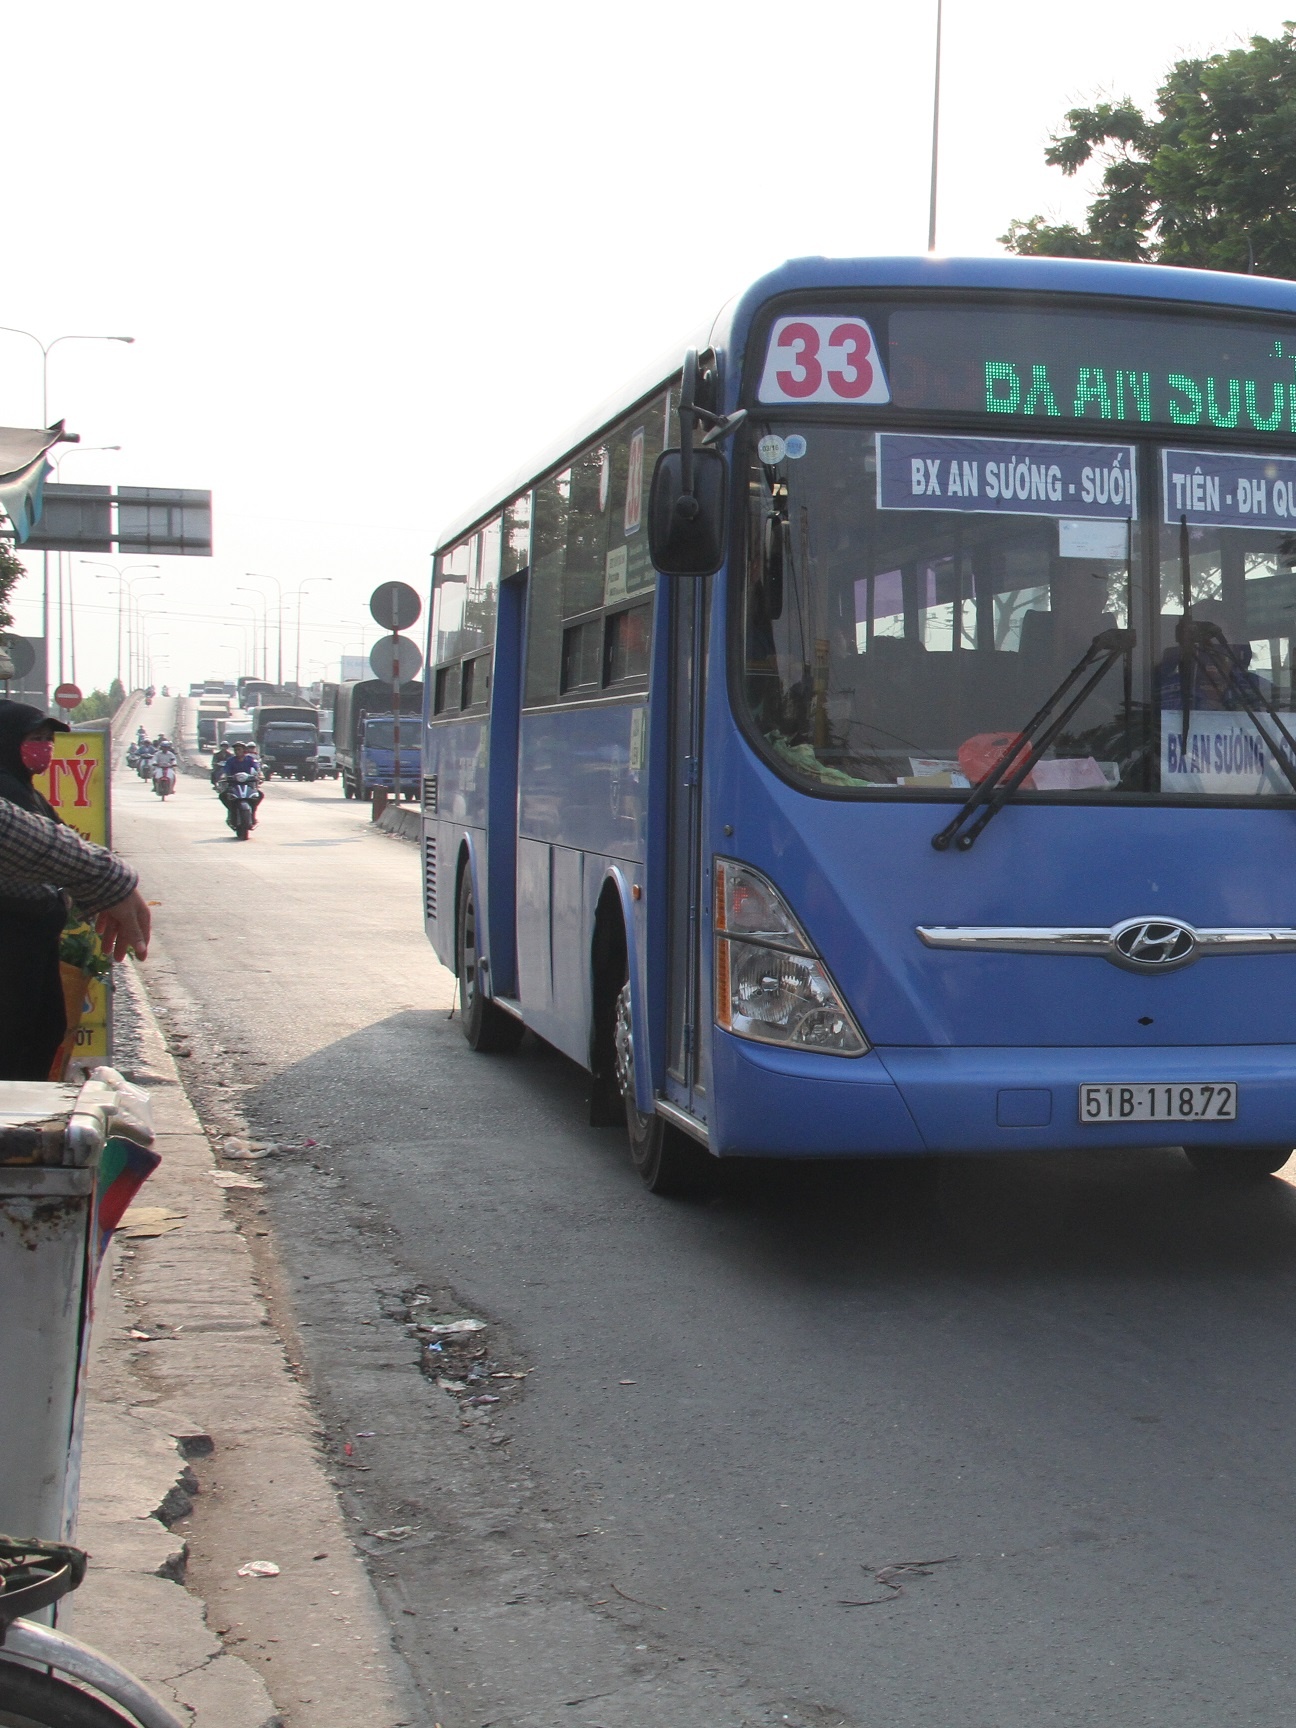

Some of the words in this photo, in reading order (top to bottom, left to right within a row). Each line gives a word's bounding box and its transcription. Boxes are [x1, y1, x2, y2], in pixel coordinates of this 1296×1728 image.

[776, 322, 873, 398] 33
[1074, 367, 1151, 422] AN
[911, 458, 942, 496] BX
[948, 460, 979, 497] AN
[985, 455, 1063, 502] SƯƠNG
[1081, 452, 1131, 505] SUỐI
[1172, 466, 1220, 512] TIÊN
[1237, 478, 1267, 514] ĐH
[1190, 734, 1211, 774] AN
[1086, 1087, 1232, 1118] 51B-118.72
